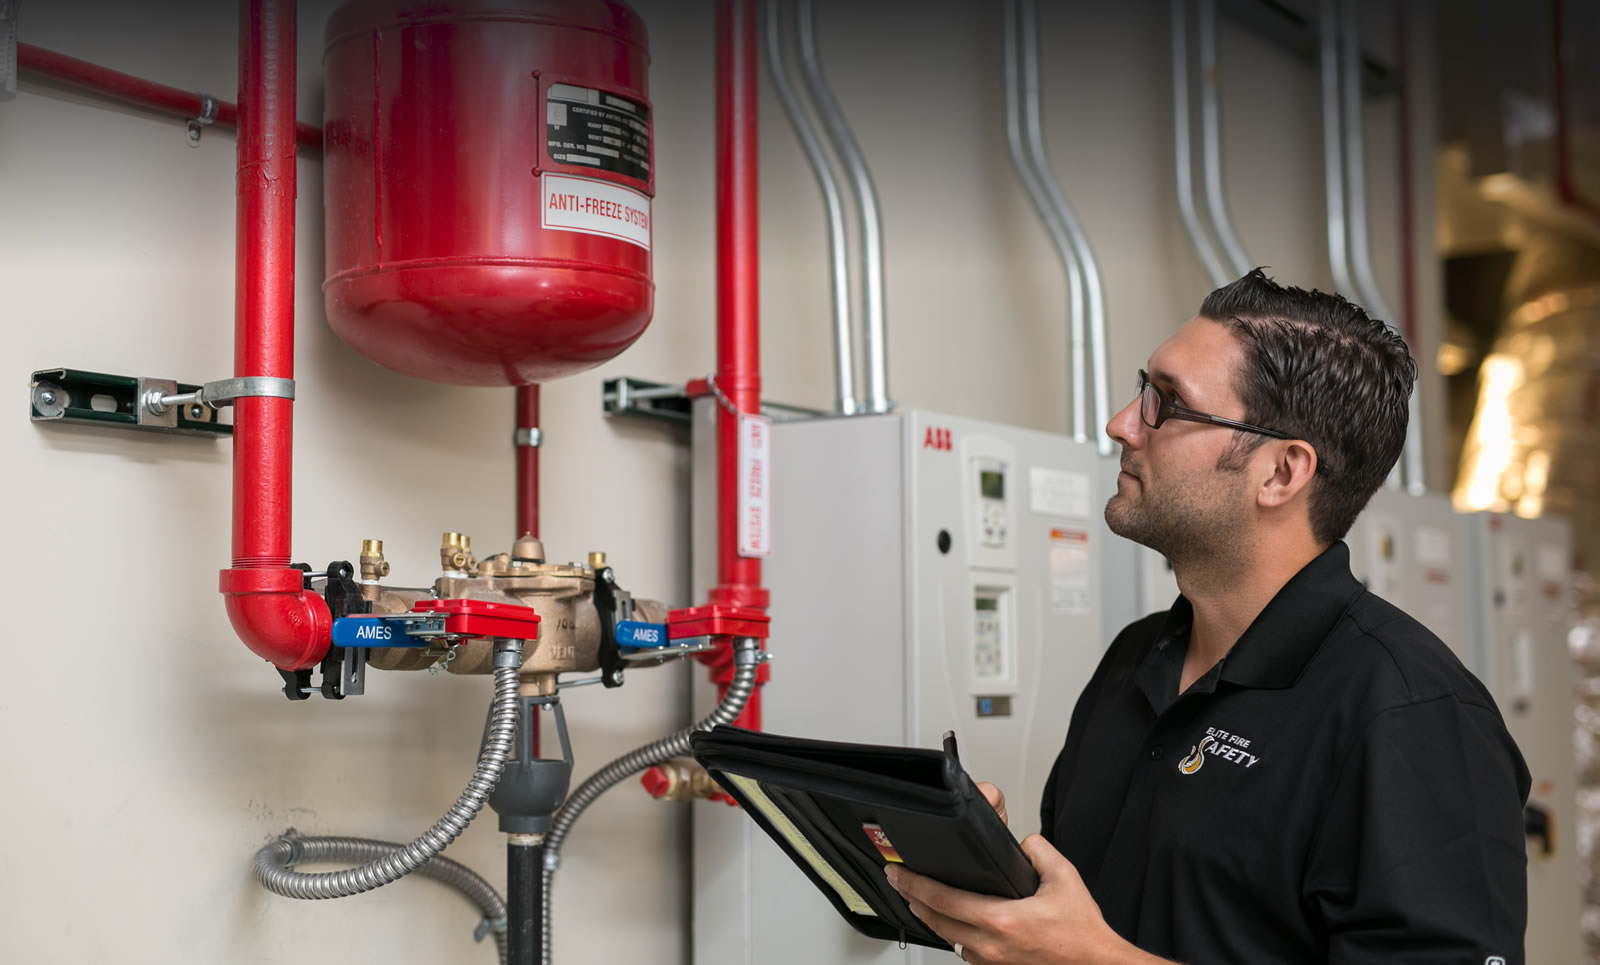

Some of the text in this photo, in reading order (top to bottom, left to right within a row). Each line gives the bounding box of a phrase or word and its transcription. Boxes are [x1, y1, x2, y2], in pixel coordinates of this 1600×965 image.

[572, 106, 598, 117] CERTIFIED
[549, 192, 622, 220] ANTI-FREEZE
[923, 426, 952, 452] ABB
[356, 625, 392, 640] AMES
[633, 627, 659, 643] AMES
[1206, 727, 1251, 748] ELITE FIRE
